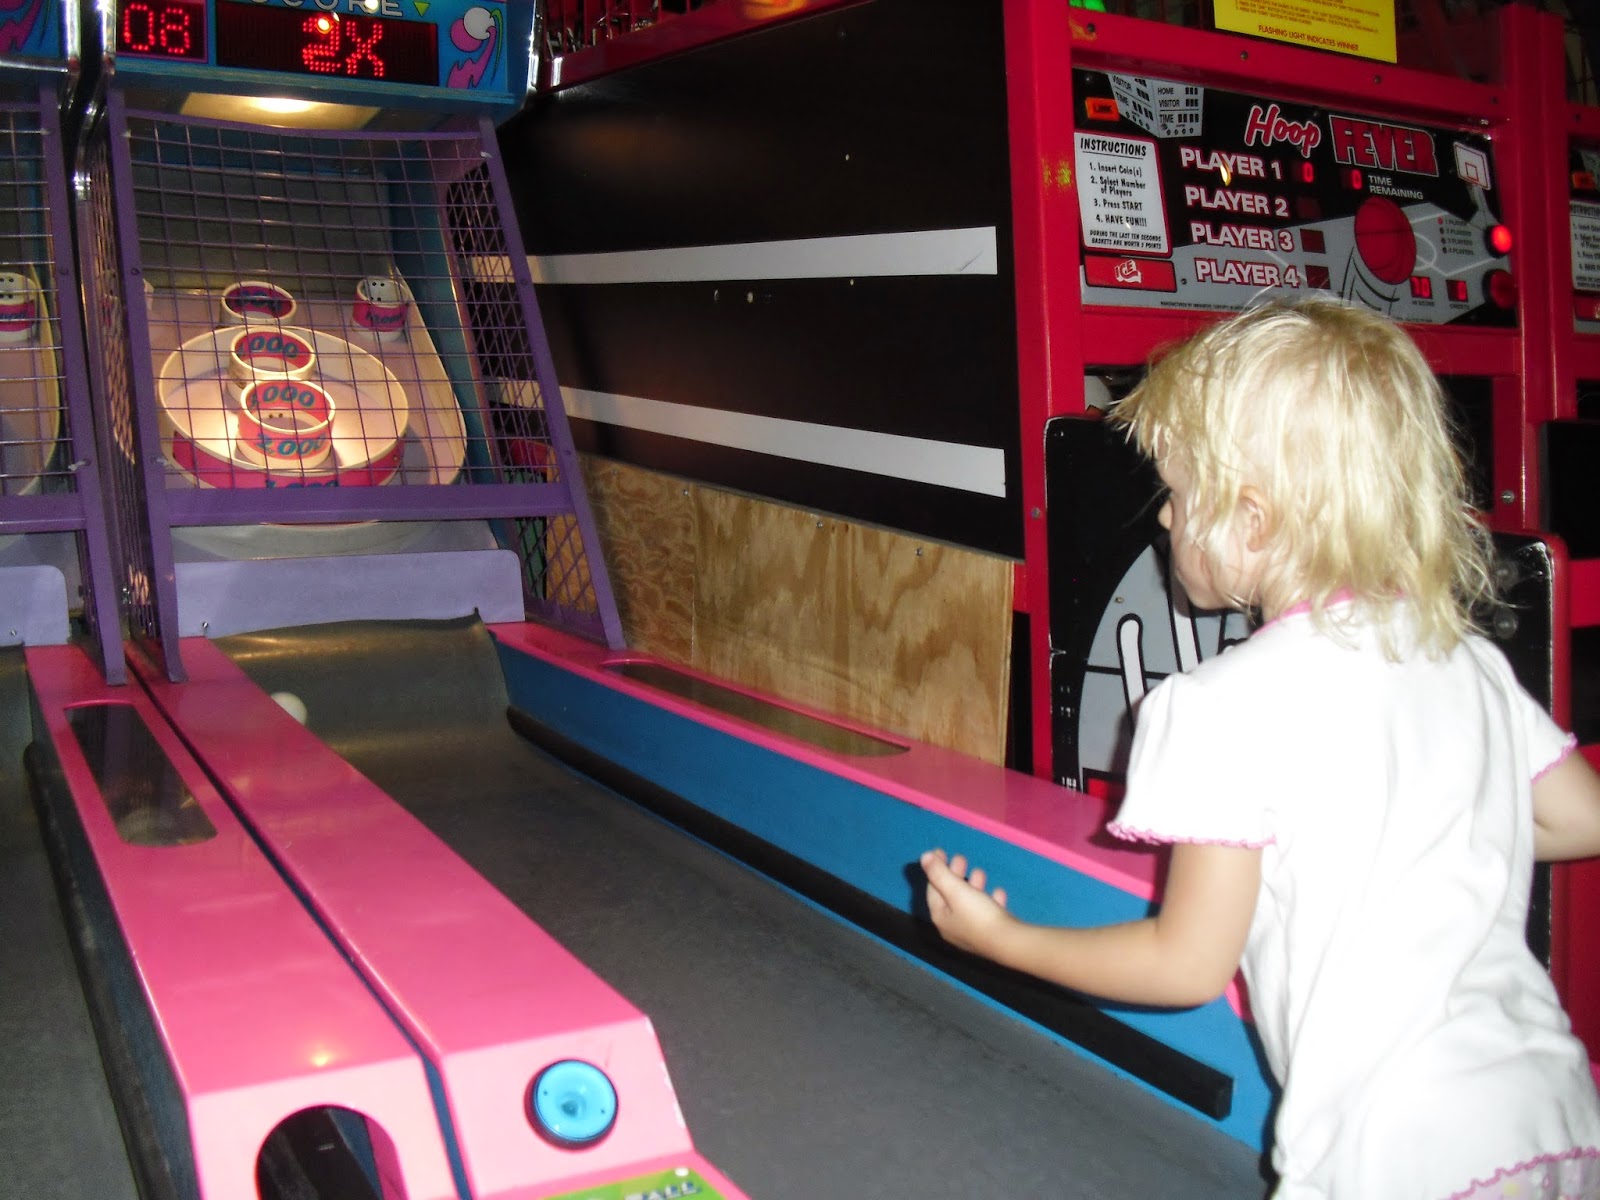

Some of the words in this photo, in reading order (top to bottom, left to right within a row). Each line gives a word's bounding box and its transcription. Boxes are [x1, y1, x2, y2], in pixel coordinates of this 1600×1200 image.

[124, 3, 190, 54] 08
[1258, 24, 1288, 38] FLASHING
[1288, 30, 1306, 41] LIGHT
[1306, 34, 1336, 47] INDICATES
[1336, 41, 1359, 51] WINNER
[302, 16, 385, 77] 2X
[1158, 87, 1175, 95] HOME
[1158, 99, 1180, 108] VISITOR
[1159, 114, 1174, 123] TIME
[1080, 138, 1147, 156] INSTRUCTIONS
[1244, 104, 1321, 158] Hoop
[1329, 114, 1439, 178] FEVER
[1089, 162, 1096, 171] 1.
[1098, 163, 1117, 173] Insert
[1118, 165, 1142, 177] Coin(s)
[1180, 147, 1265, 178] PLAYER
[1271, 161, 1281, 180] 1
[1090, 176, 1097, 184] 2.
[1100, 176, 1119, 186] Select
[1121, 180, 1146, 189] Number
[1368, 175, 1392, 186] TIME
[1101, 185, 1107, 194] of
[1109, 186, 1132, 198] Players
[1369, 185, 1424, 200] REMAINING
[1094, 199, 1101, 207] 3.
[1103, 199, 1120, 209] Press
[1122, 201, 1143, 211] START
[1185, 185, 1270, 215] PLAYER
[1275, 197, 1289, 217] 2
[1095, 214, 1103, 223] 4.
[1105, 214, 1124, 224] HAVE
[1141, 234, 1161, 242] SECONDS
[1190, 221, 1276, 251] PLAYER
[1279, 230, 1294, 252] 3
[1114, 259, 1141, 283] ICE
[1194, 258, 1282, 287] PLAYER
[1284, 265, 1300, 288] 4
